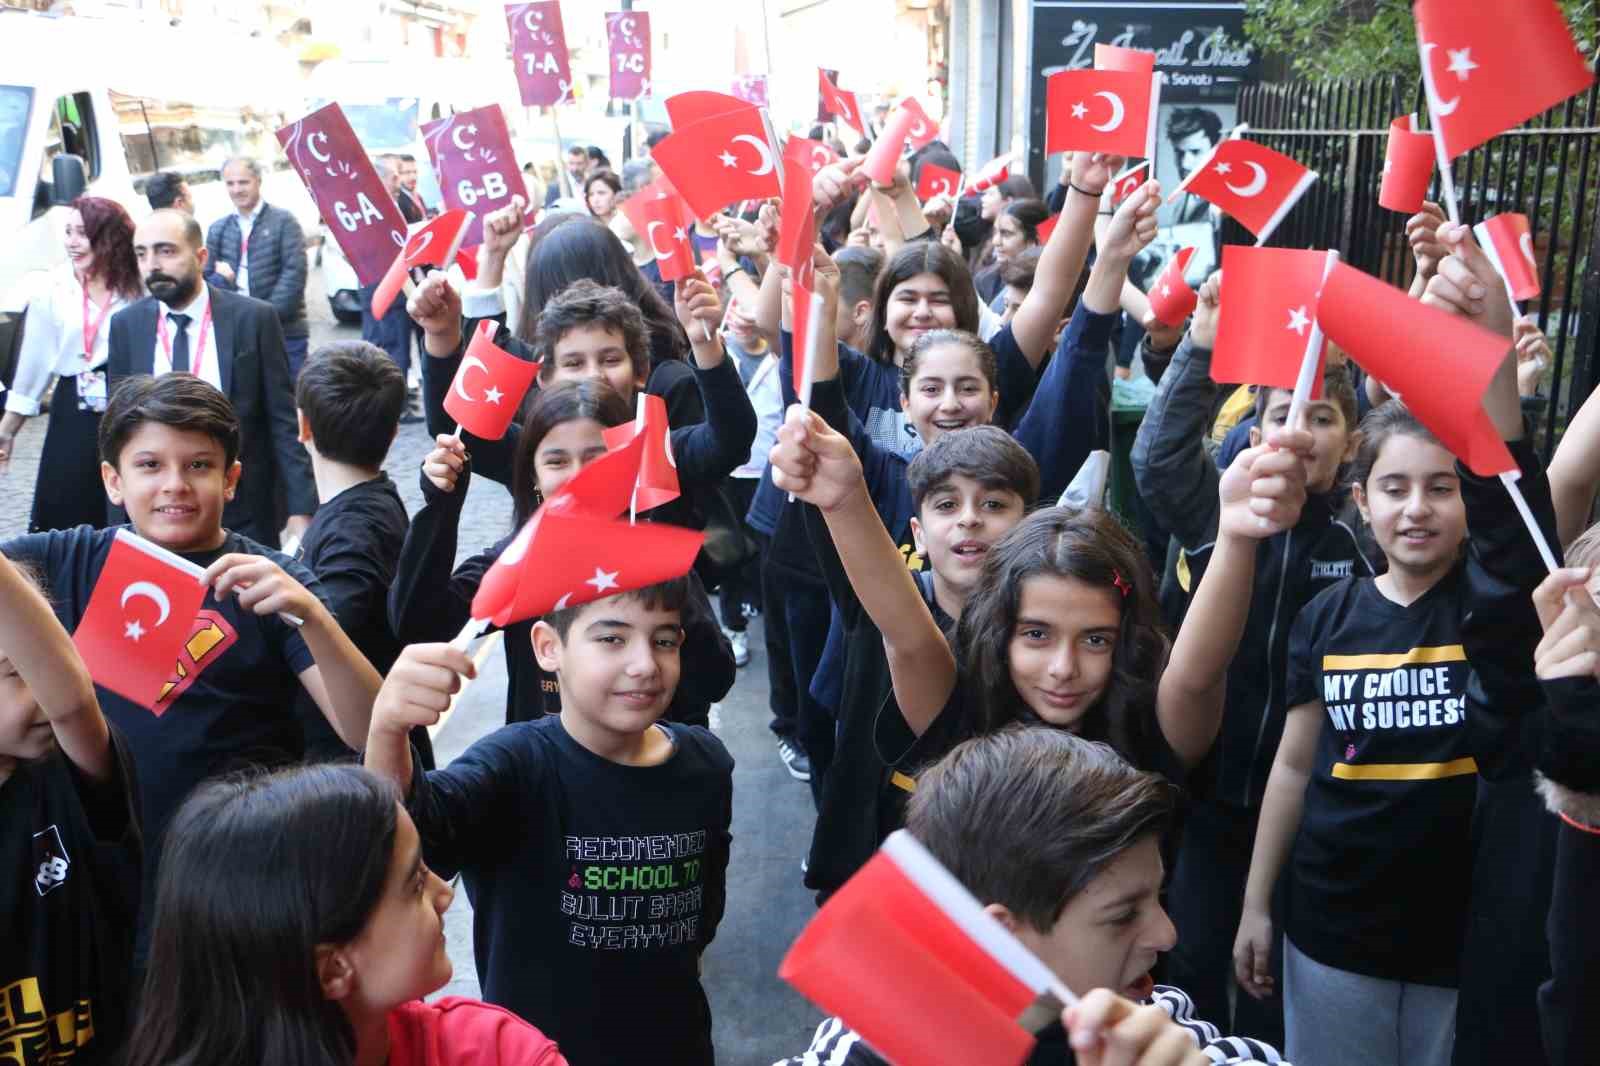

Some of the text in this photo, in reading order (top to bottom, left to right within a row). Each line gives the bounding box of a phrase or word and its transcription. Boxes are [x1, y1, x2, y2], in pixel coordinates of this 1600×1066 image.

[523, 53, 560, 75] 7-A
[616, 53, 645, 73] 7-C
[456, 172, 508, 206] 6-B
[334, 191, 383, 233] 6-A
[1323, 667, 1450, 702] MY CHOICE
[1327, 703, 1357, 730] MY
[584, 864, 679, 890] SCHOOL
